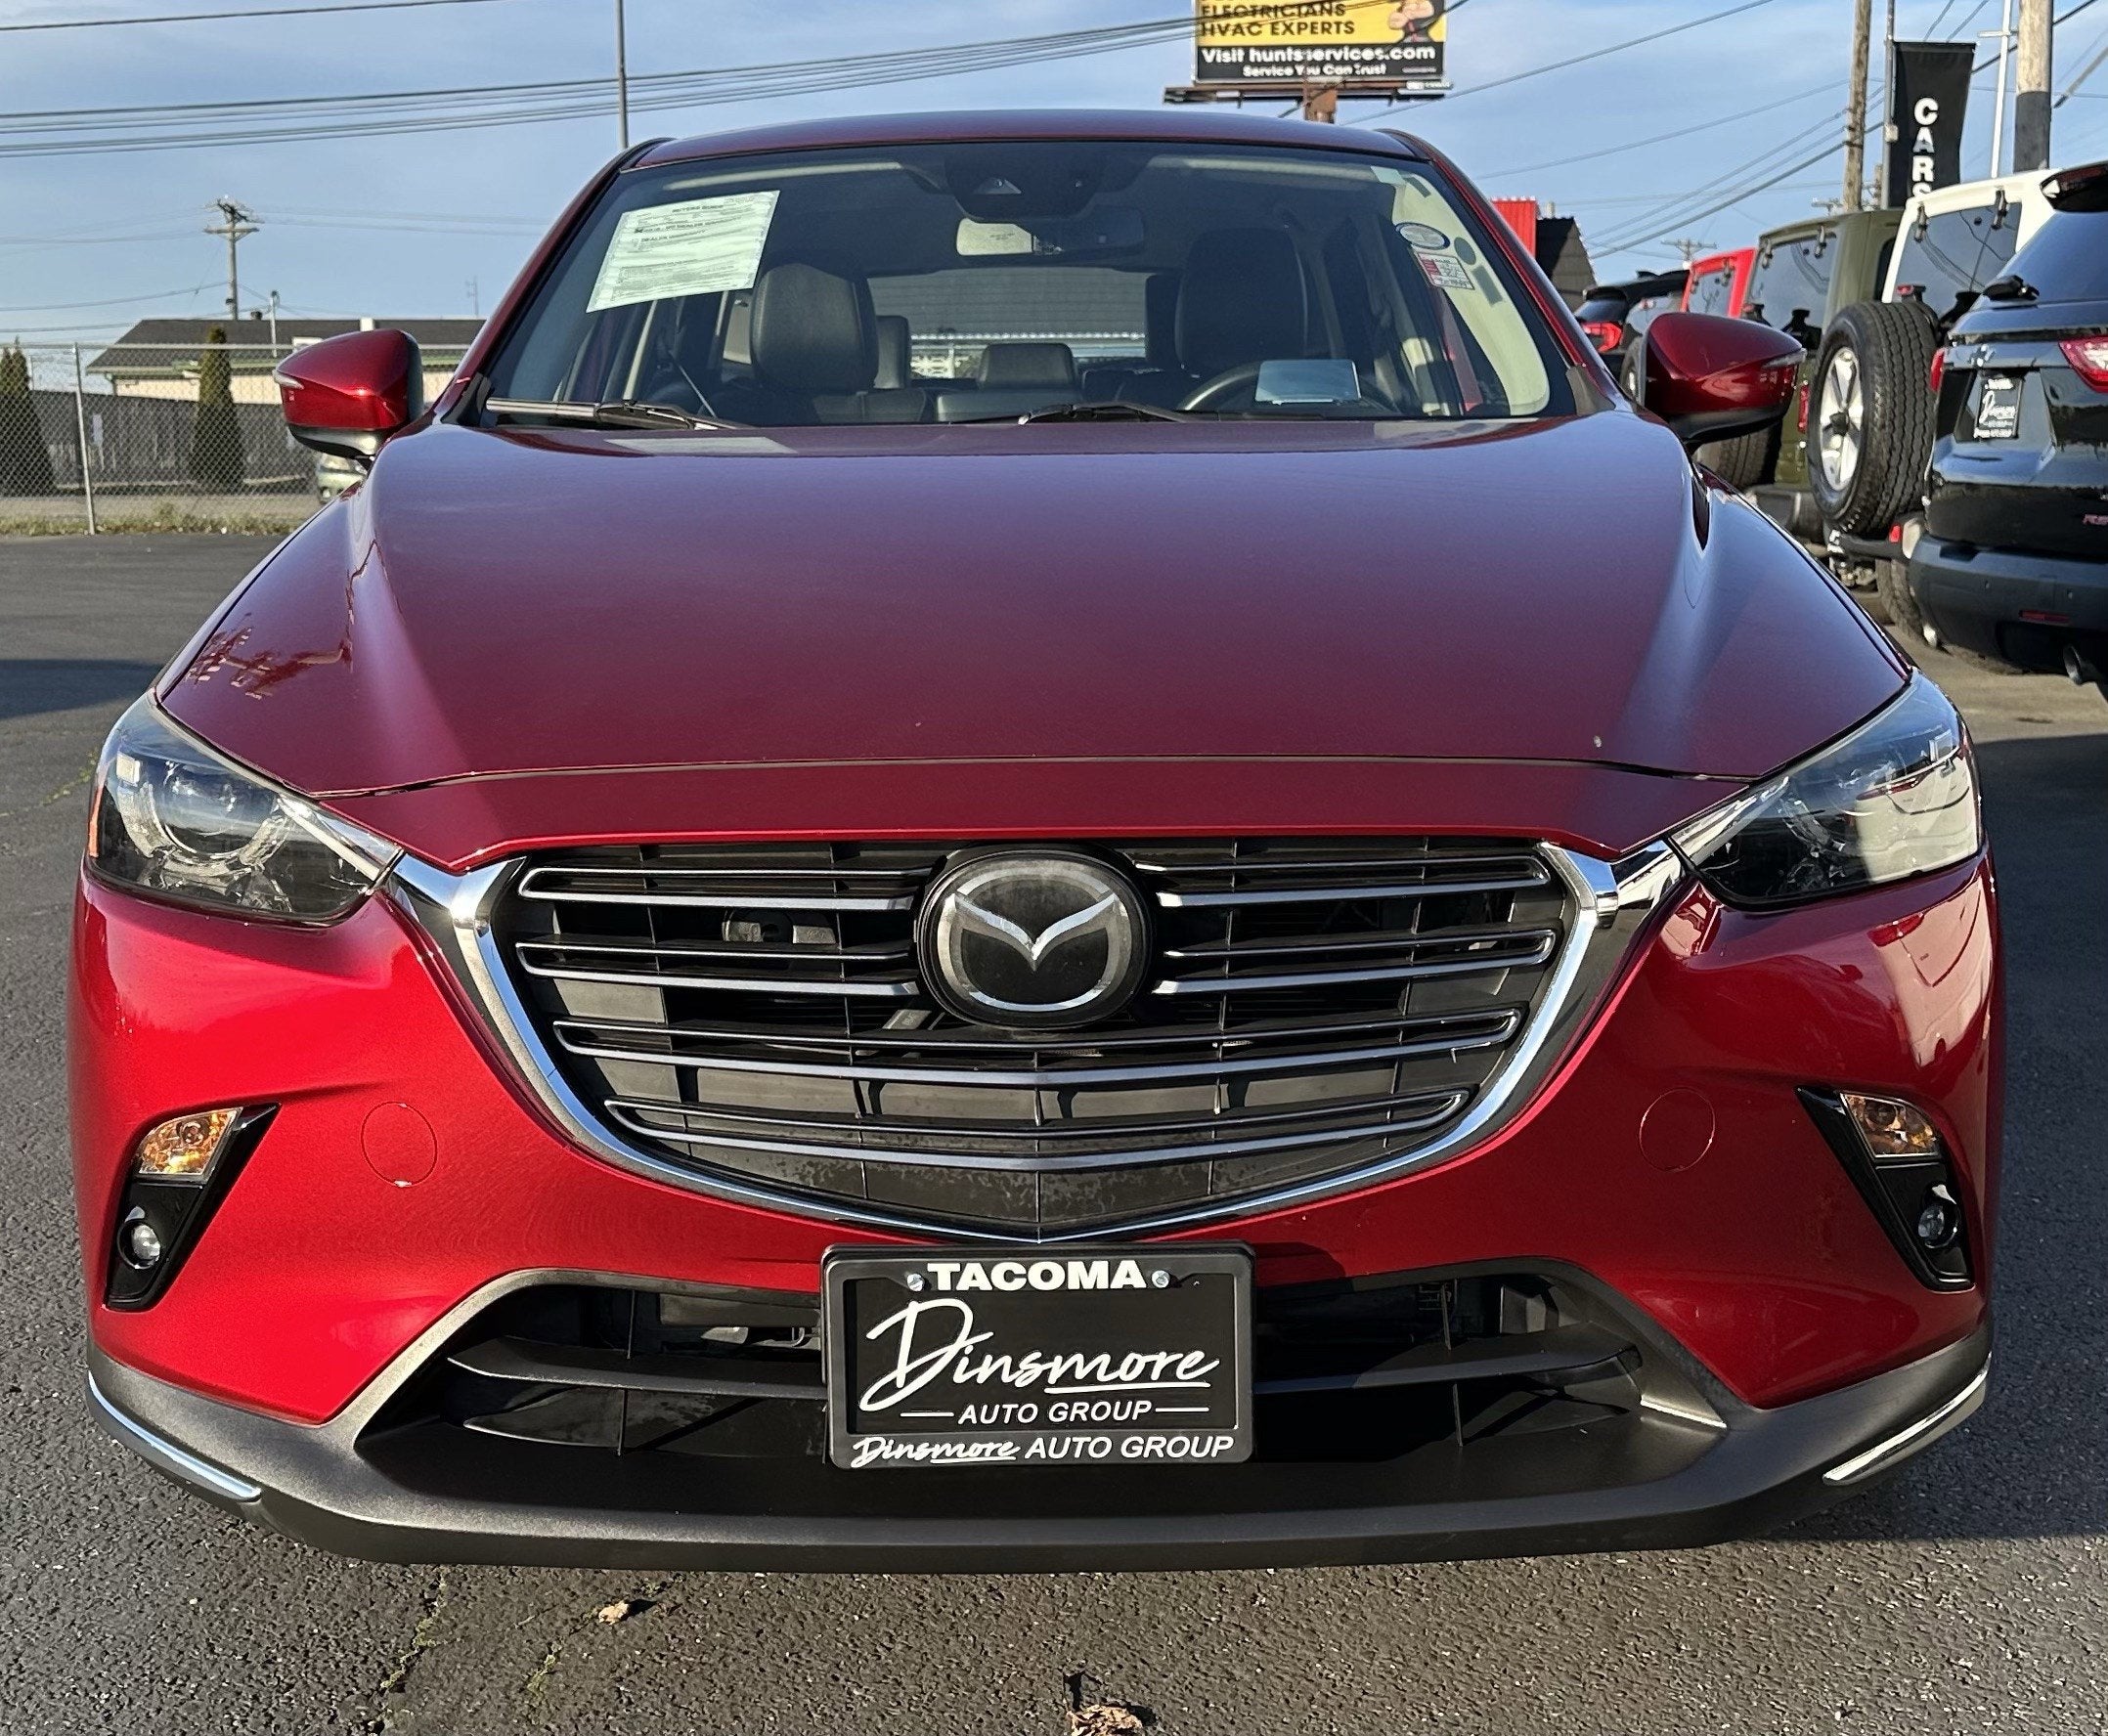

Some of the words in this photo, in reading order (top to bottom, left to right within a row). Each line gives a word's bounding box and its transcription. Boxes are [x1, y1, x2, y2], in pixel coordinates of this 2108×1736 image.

[1202, 3, 1345, 18] ELECTRICIANS
[1201, 22, 1262, 36] HVAC
[1270, 21, 1355, 35] EXPERTS
[1202, 49, 1245, 63] Visit
[1243, 65, 1294, 77] Service
[1322, 64, 1353, 76] Can
[927, 1260, 1146, 1291] TACOMA
[859, 1298, 1220, 1411] Dinsmore
[958, 1403, 1038, 1424] AUTO
[1048, 1400, 1152, 1423] GROUP
[850, 1436, 1020, 1468] Dinsmore
[1025, 1438, 1112, 1459] AUTO
[1120, 1435, 1234, 1458] GROUP
